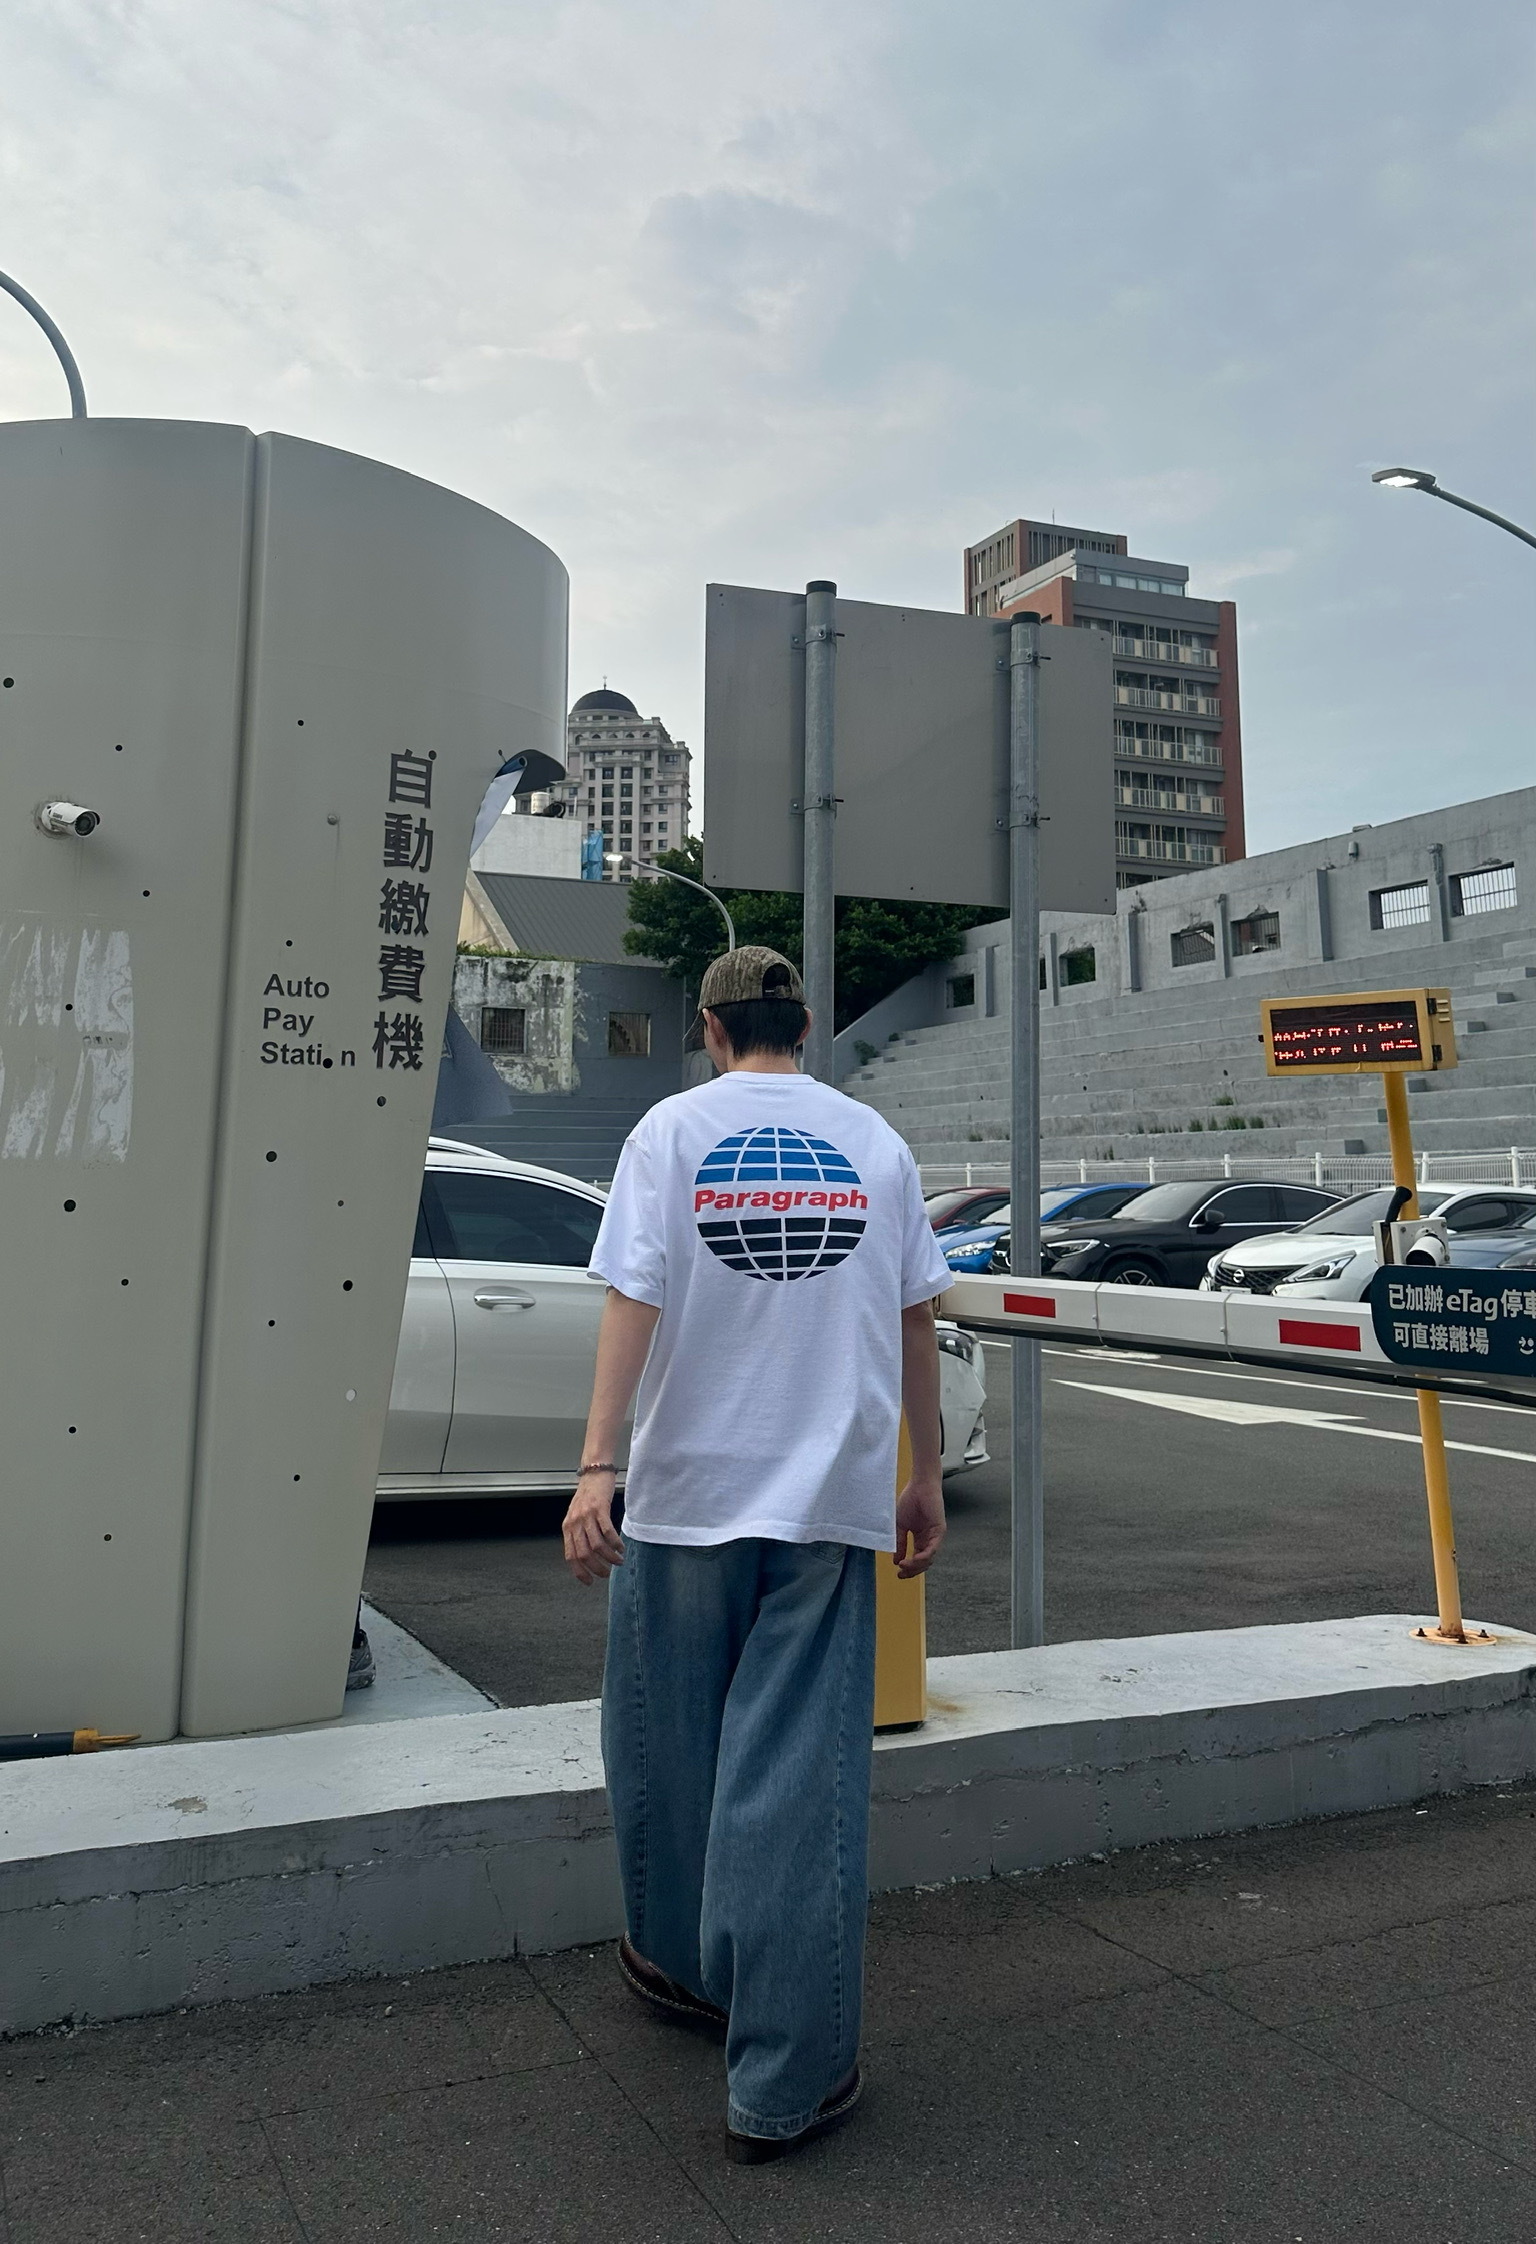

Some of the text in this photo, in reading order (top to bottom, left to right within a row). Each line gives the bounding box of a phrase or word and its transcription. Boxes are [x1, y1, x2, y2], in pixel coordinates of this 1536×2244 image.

[372, 749, 434, 1071] 自動繳費機
[263, 973, 330, 999] Auto
[263, 1007, 315, 1037] Pay
[260, 1041, 356, 1068] Statin
[694, 1189, 868, 1213] Paragraph
[1393, 1321, 1490, 1355] 可直接離場
